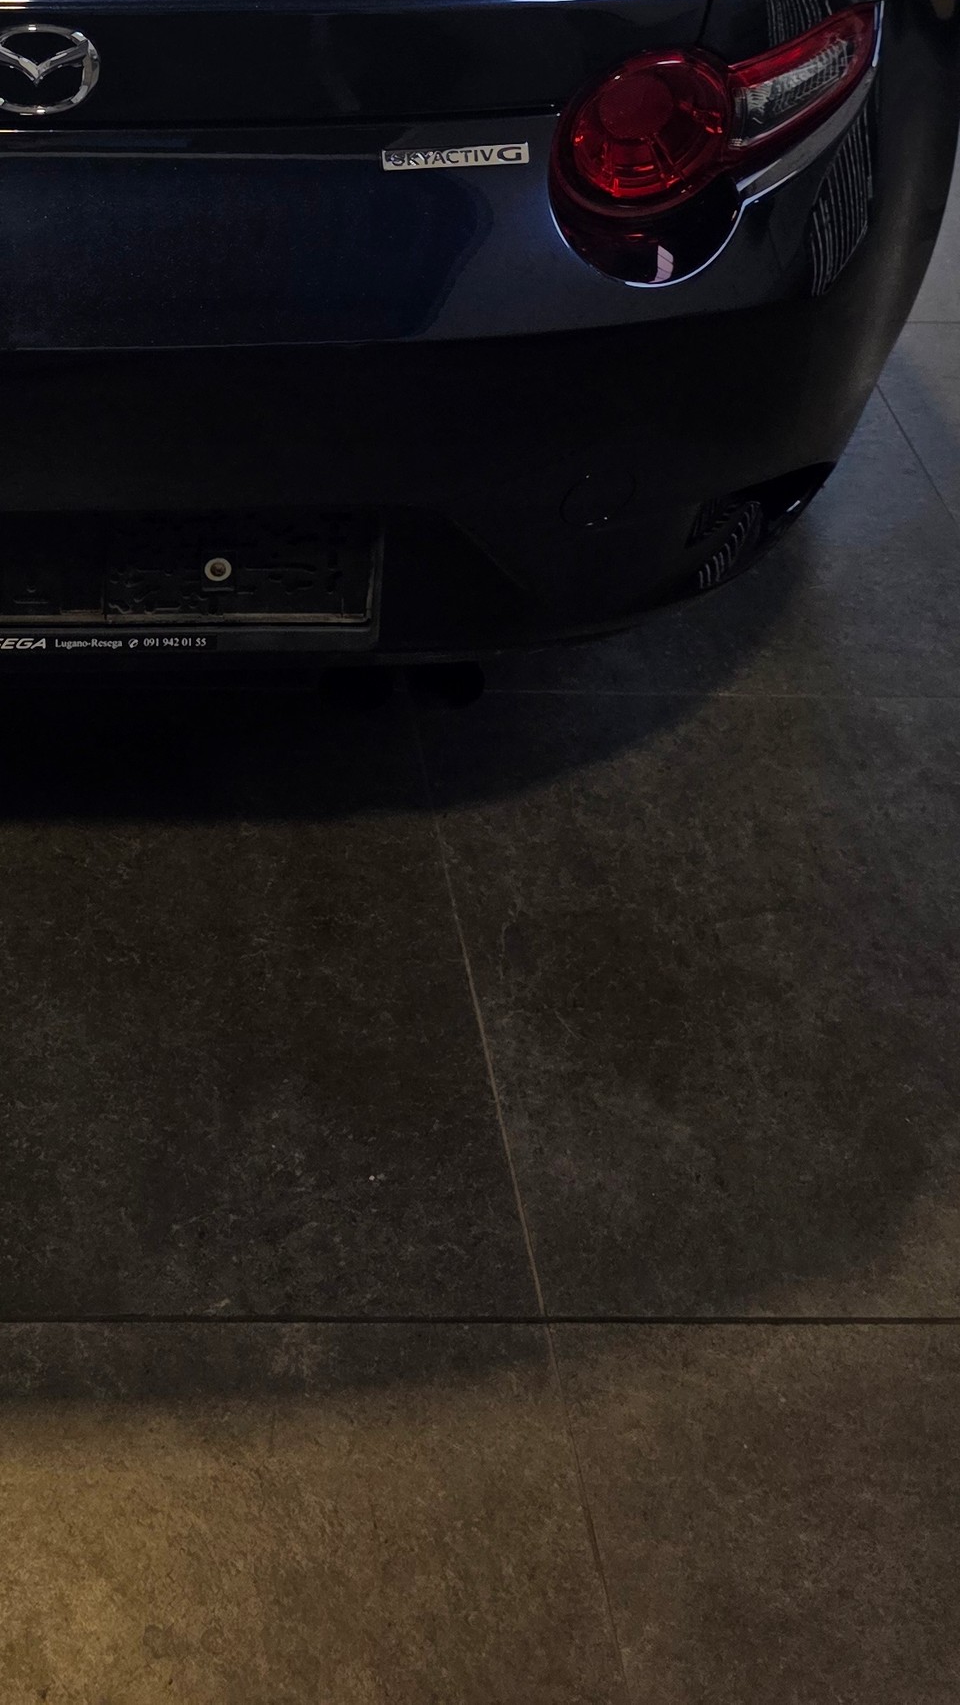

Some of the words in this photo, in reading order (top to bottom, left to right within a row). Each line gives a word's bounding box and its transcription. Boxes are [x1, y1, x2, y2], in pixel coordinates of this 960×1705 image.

[54, 637, 123, 650] Lugano-Resega
[143, 637, 160, 647] 091
[162, 637, 181, 647] 942
[182, 637, 193, 647] 01
[195, 637, 207, 647] 55
